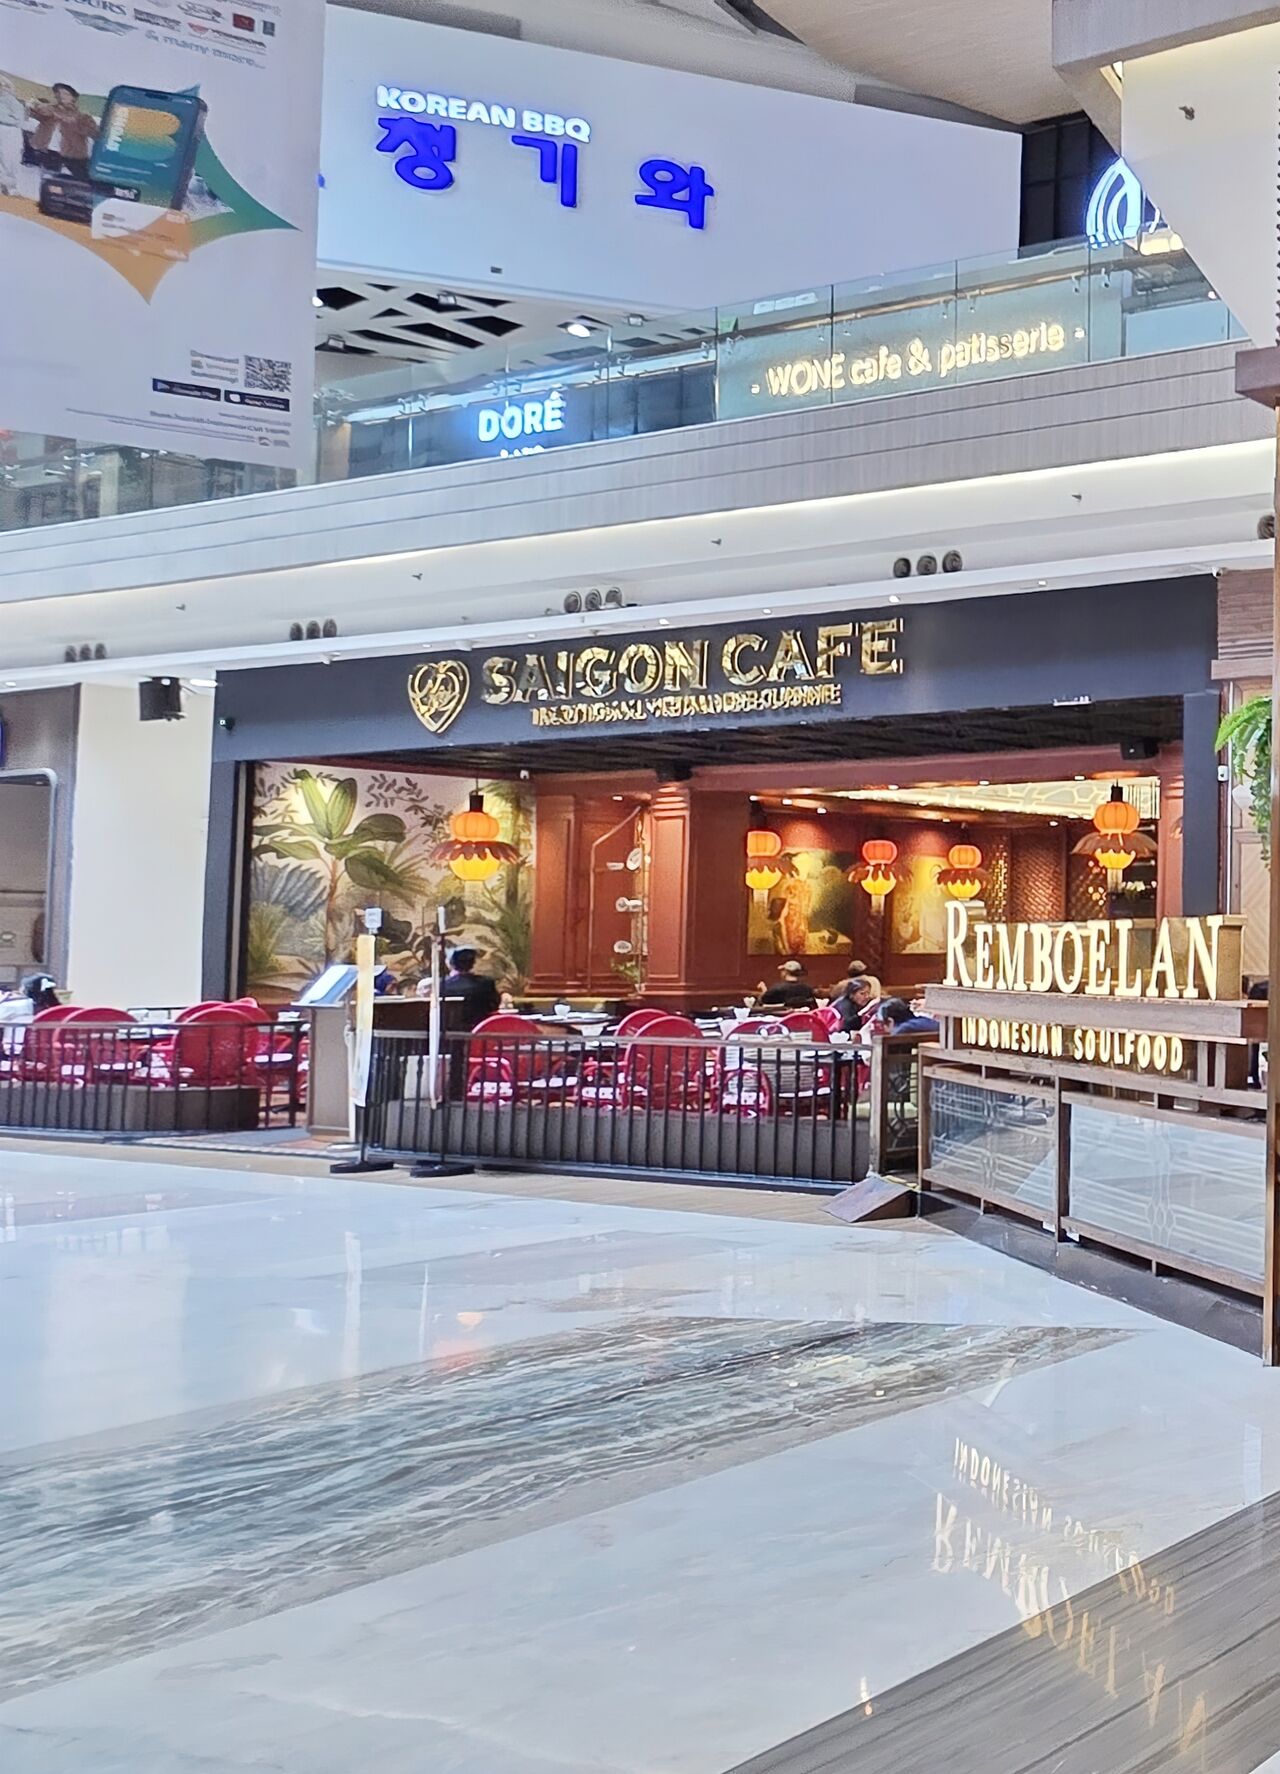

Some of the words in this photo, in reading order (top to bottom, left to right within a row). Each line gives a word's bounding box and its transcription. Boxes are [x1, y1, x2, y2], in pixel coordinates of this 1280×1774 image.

[376, 85, 516, 129] KOREAN
[521, 109, 592, 143] BBQ
[764, 352, 846, 397] WONE
[849, 346, 902, 386] cafe
[905, 337, 932, 376] &
[937, 322, 1065, 378] patisserie
[478, 390, 567, 442] DORÉ
[480, 638, 709, 706] SAIGON
[721, 617, 905, 687] CAFE
[942, 900, 1225, 1001] REMBOELAN
[961, 1016, 1063, 1057] INDONESIAN
[1073, 1027, 1184, 1073] SOULFOOD
